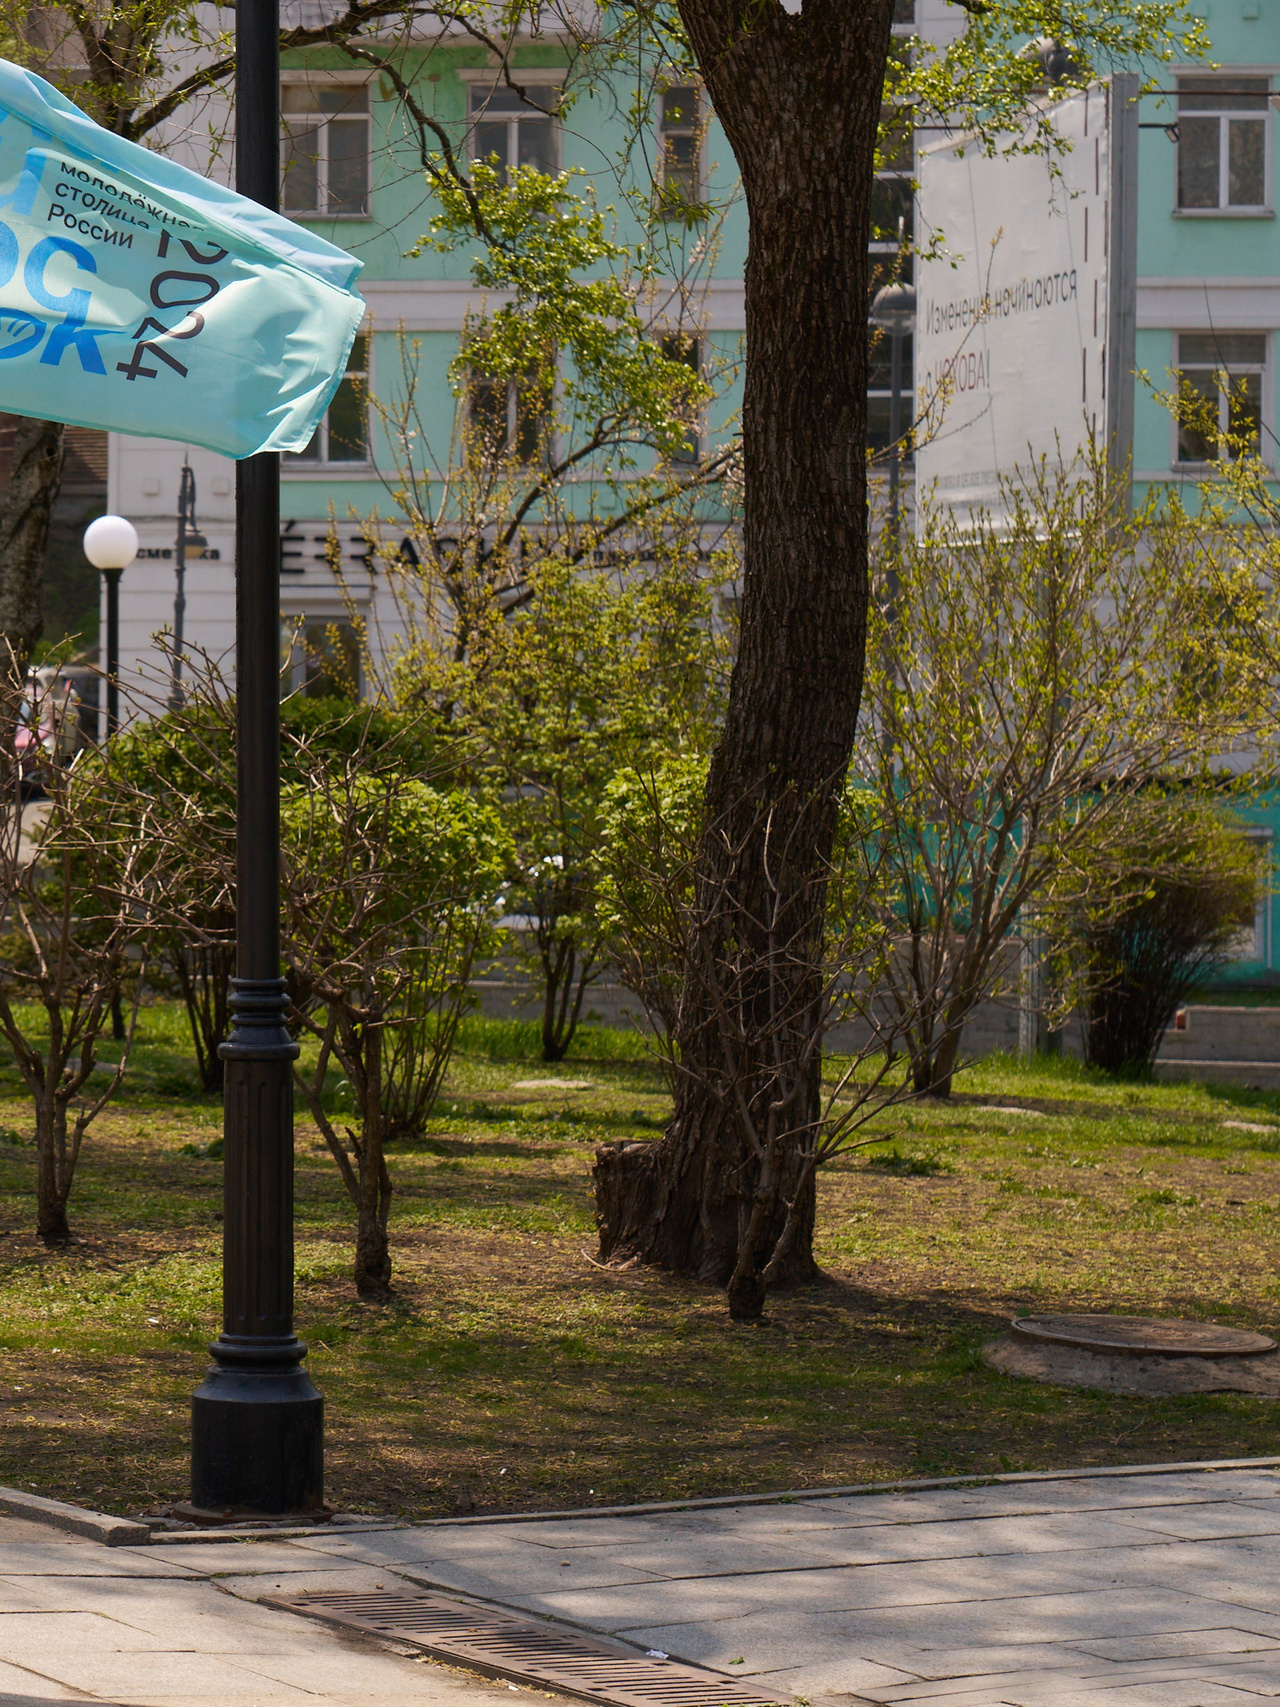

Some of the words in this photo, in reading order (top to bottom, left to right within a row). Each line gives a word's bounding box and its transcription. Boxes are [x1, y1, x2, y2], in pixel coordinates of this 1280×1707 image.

[47, 203, 133, 249] России
[55, 183, 150, 230] столица
[116, 228, 229, 381] 2024
